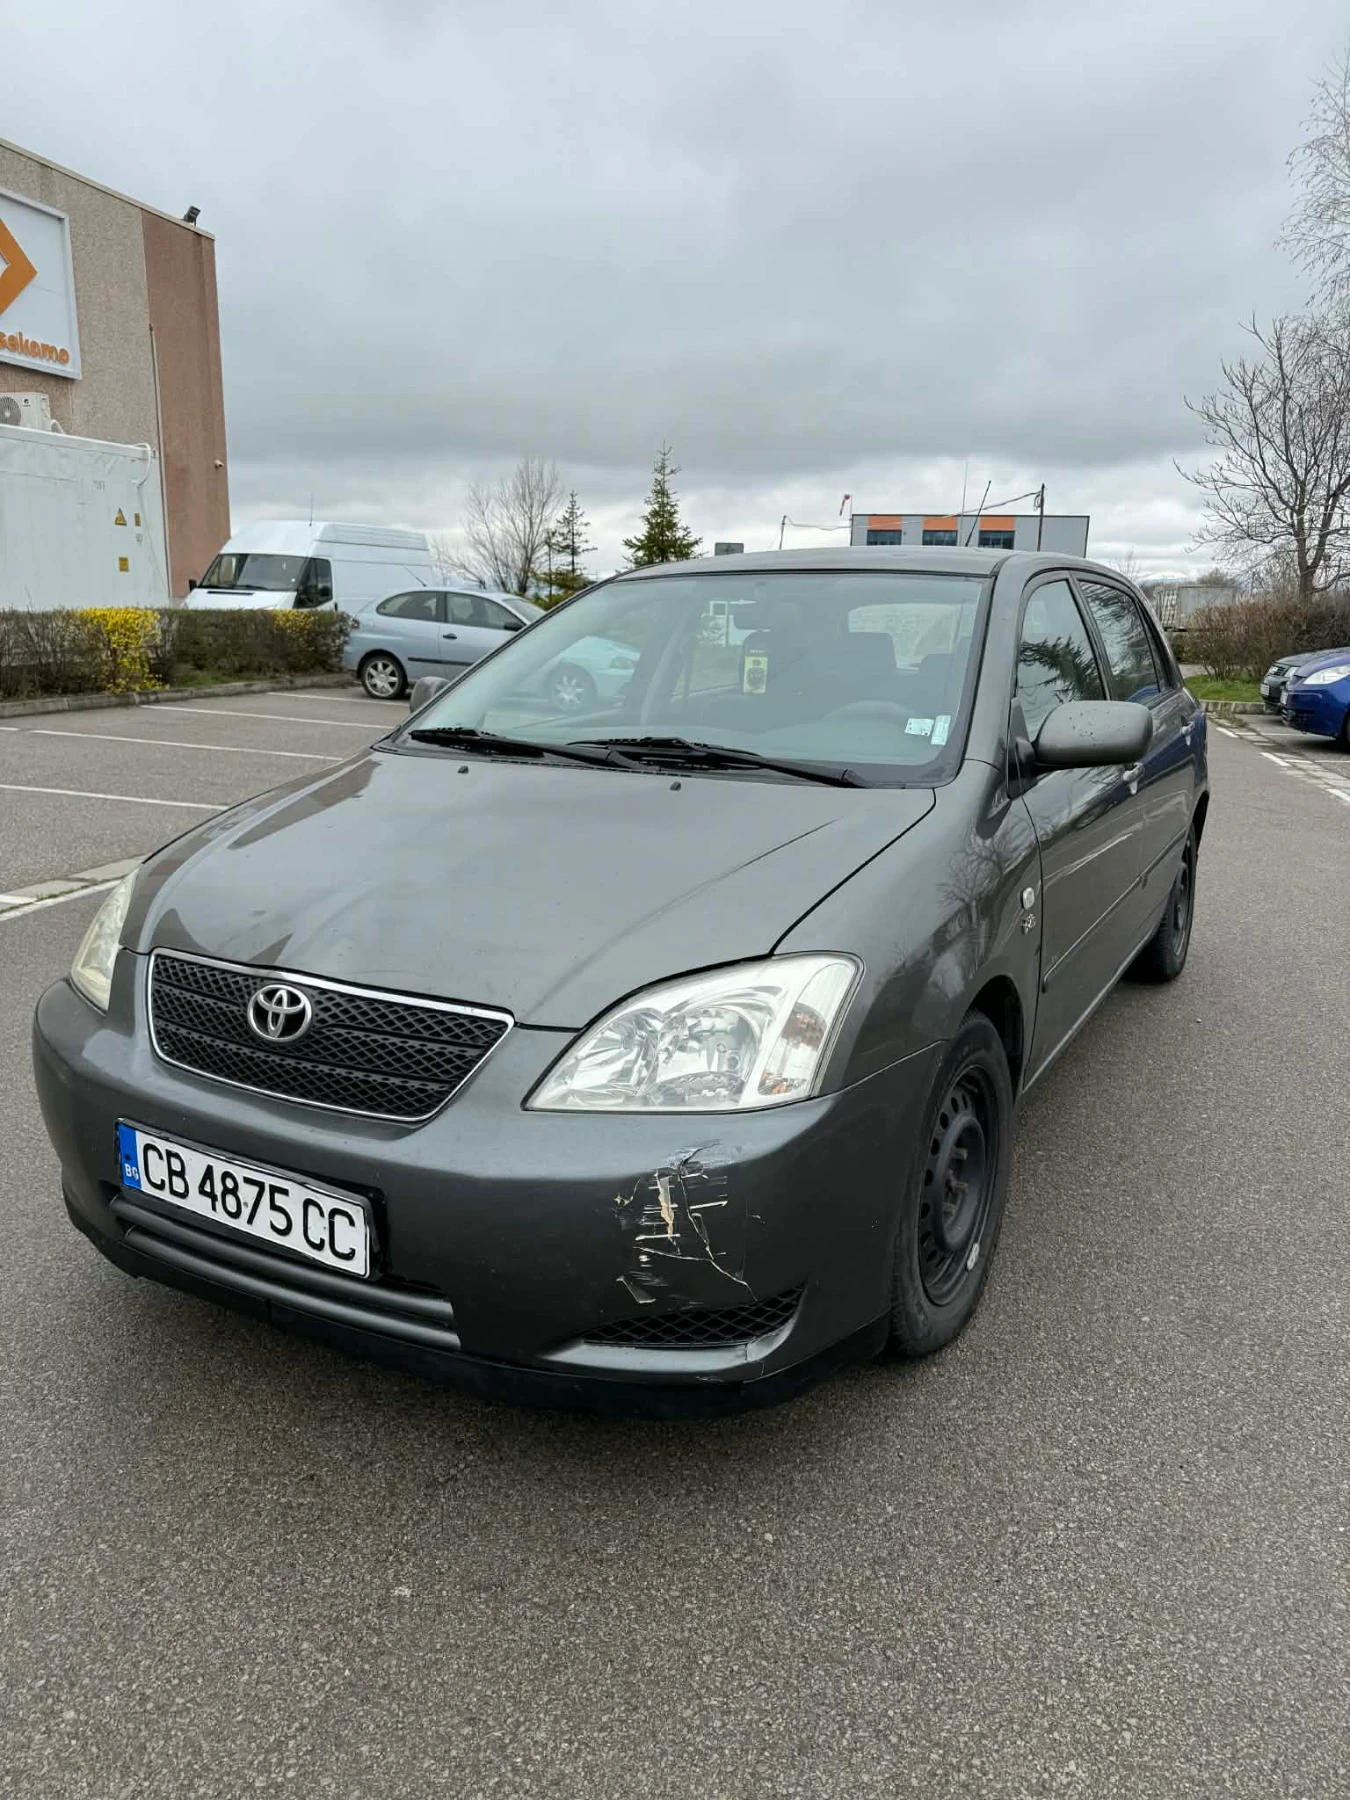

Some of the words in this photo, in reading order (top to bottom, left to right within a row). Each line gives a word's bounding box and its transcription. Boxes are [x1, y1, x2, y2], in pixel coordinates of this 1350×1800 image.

[124, 1163, 140, 1181] BG
[143, 1143, 190, 1199] CB
[198, 1164, 293, 1236] 4875
[303, 1198, 356, 1261] CC
